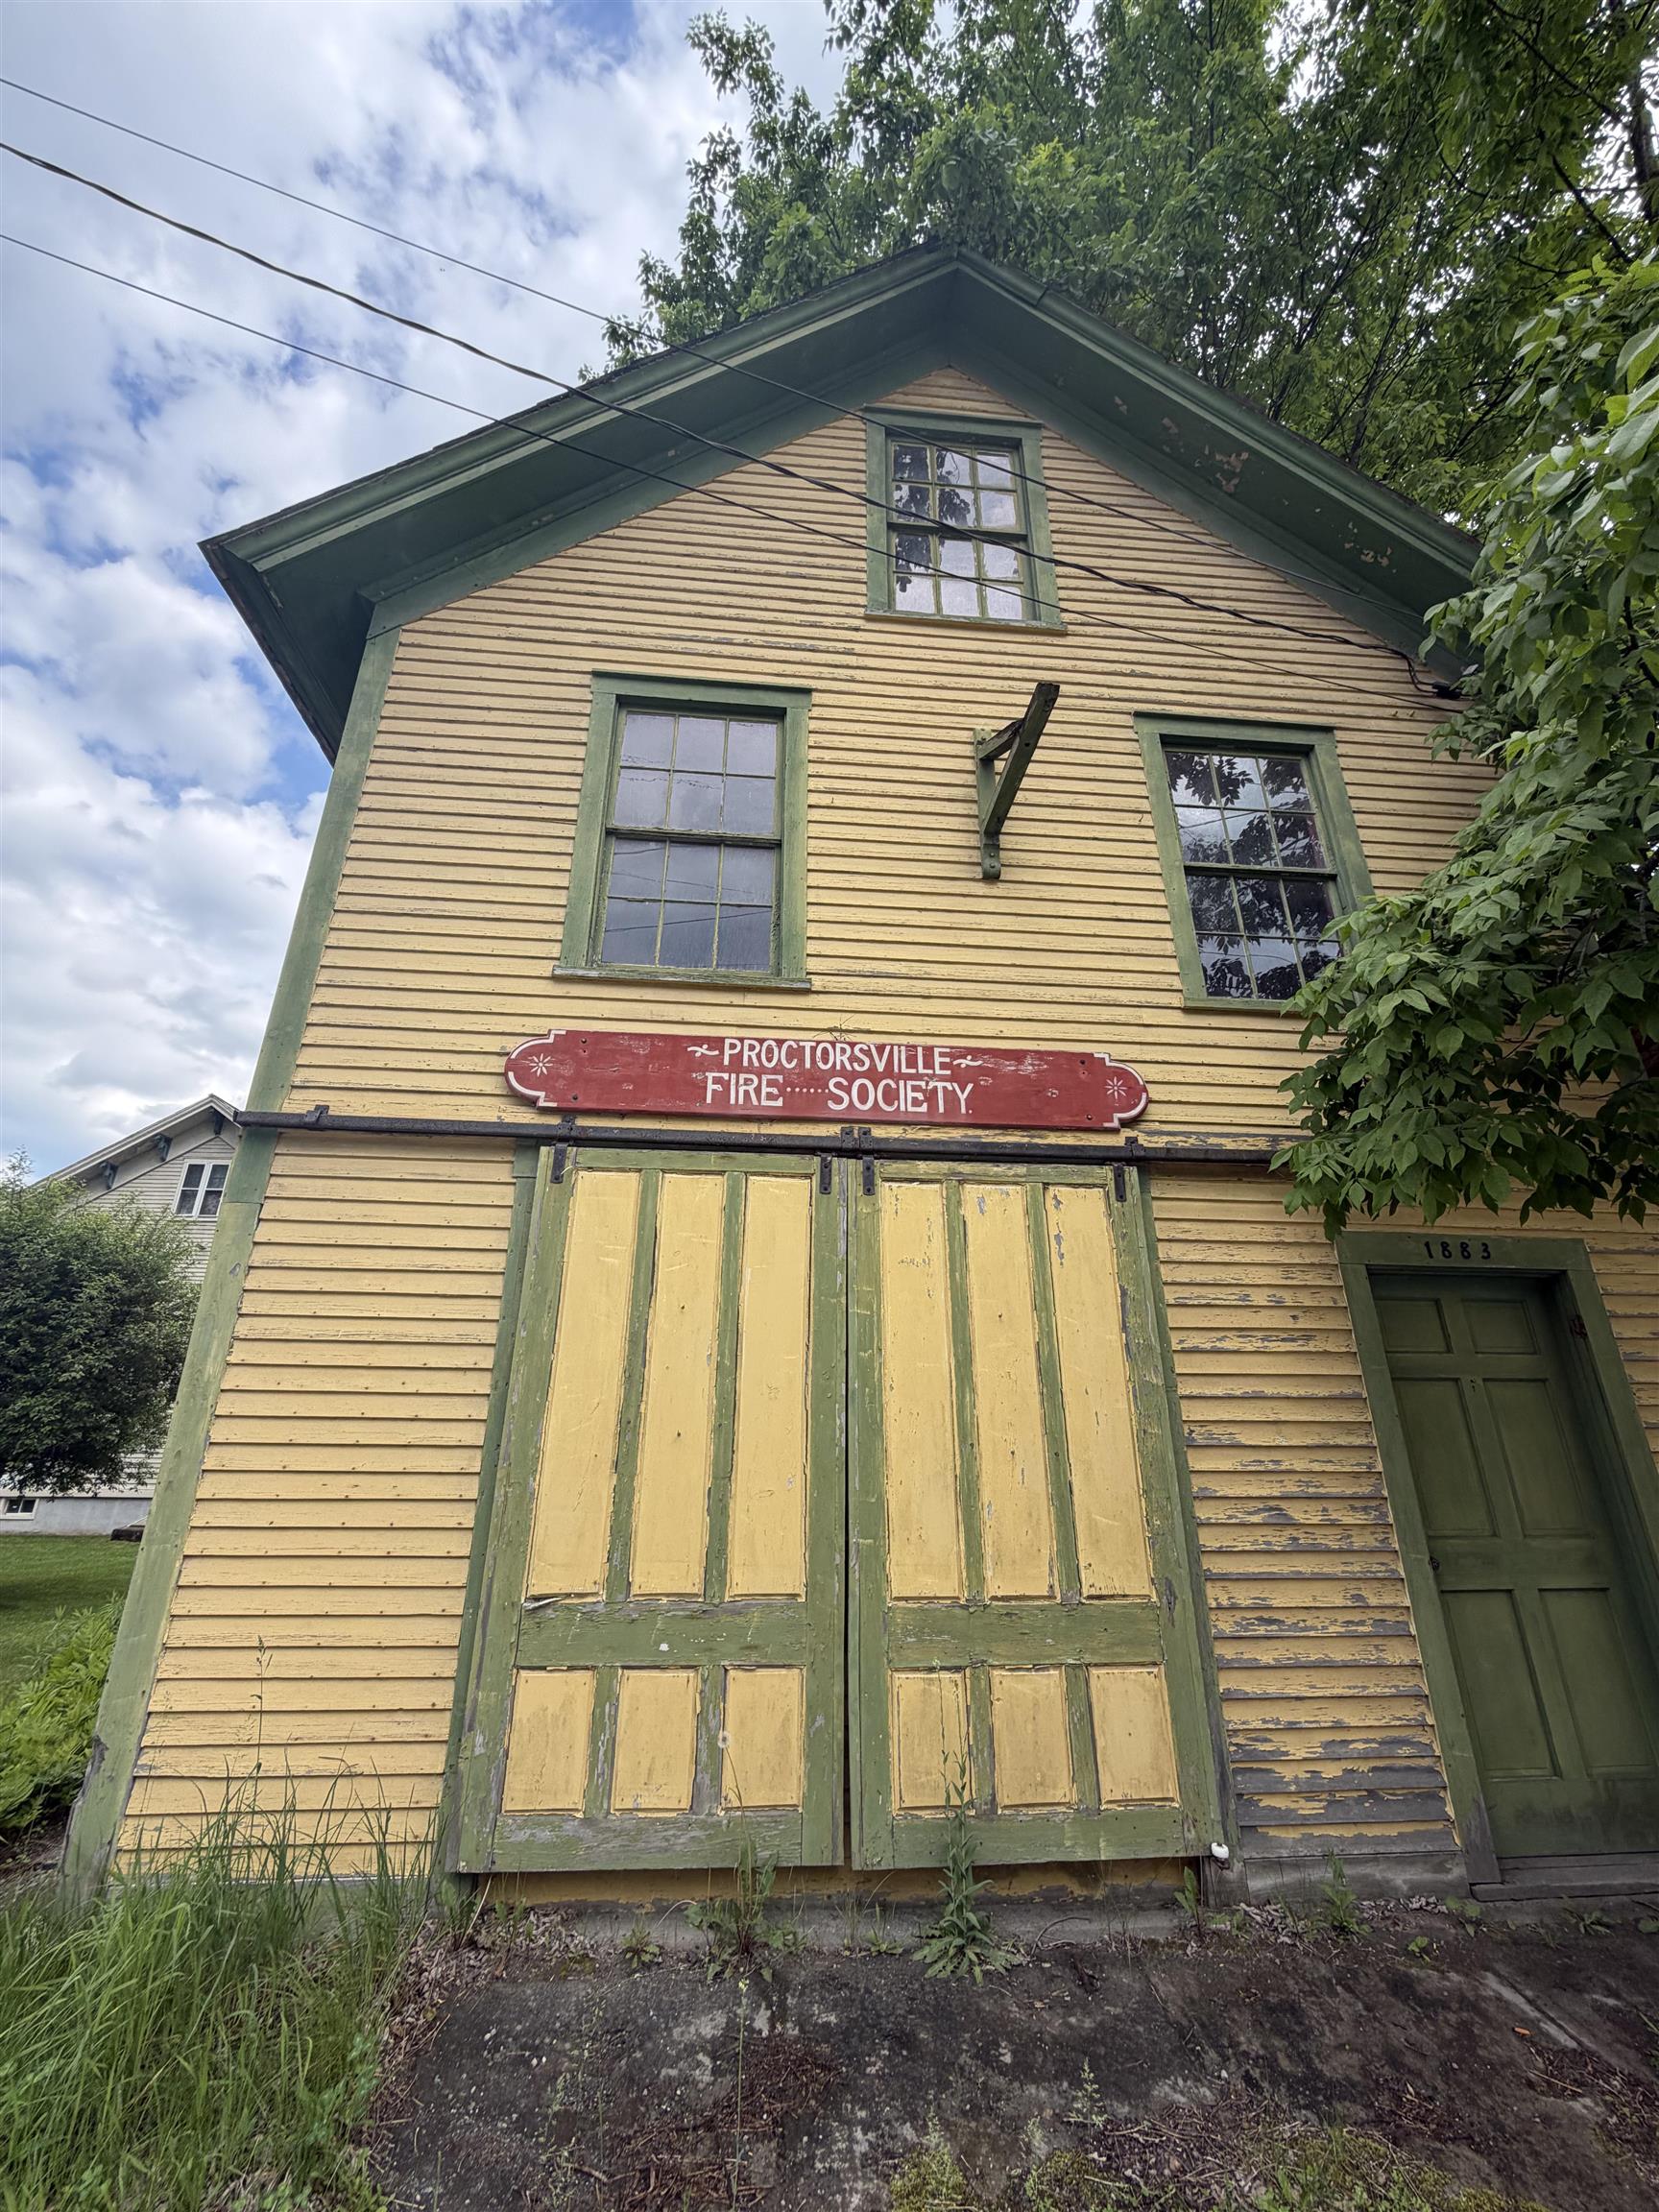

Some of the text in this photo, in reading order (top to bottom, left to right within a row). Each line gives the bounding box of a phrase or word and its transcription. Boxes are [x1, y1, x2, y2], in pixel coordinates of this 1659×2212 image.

[723, 1038, 951, 1075] PROCTORSVILLE
[706, 1072, 783, 1107] FIRE
[1424, 1240, 1491, 1260] 1883
